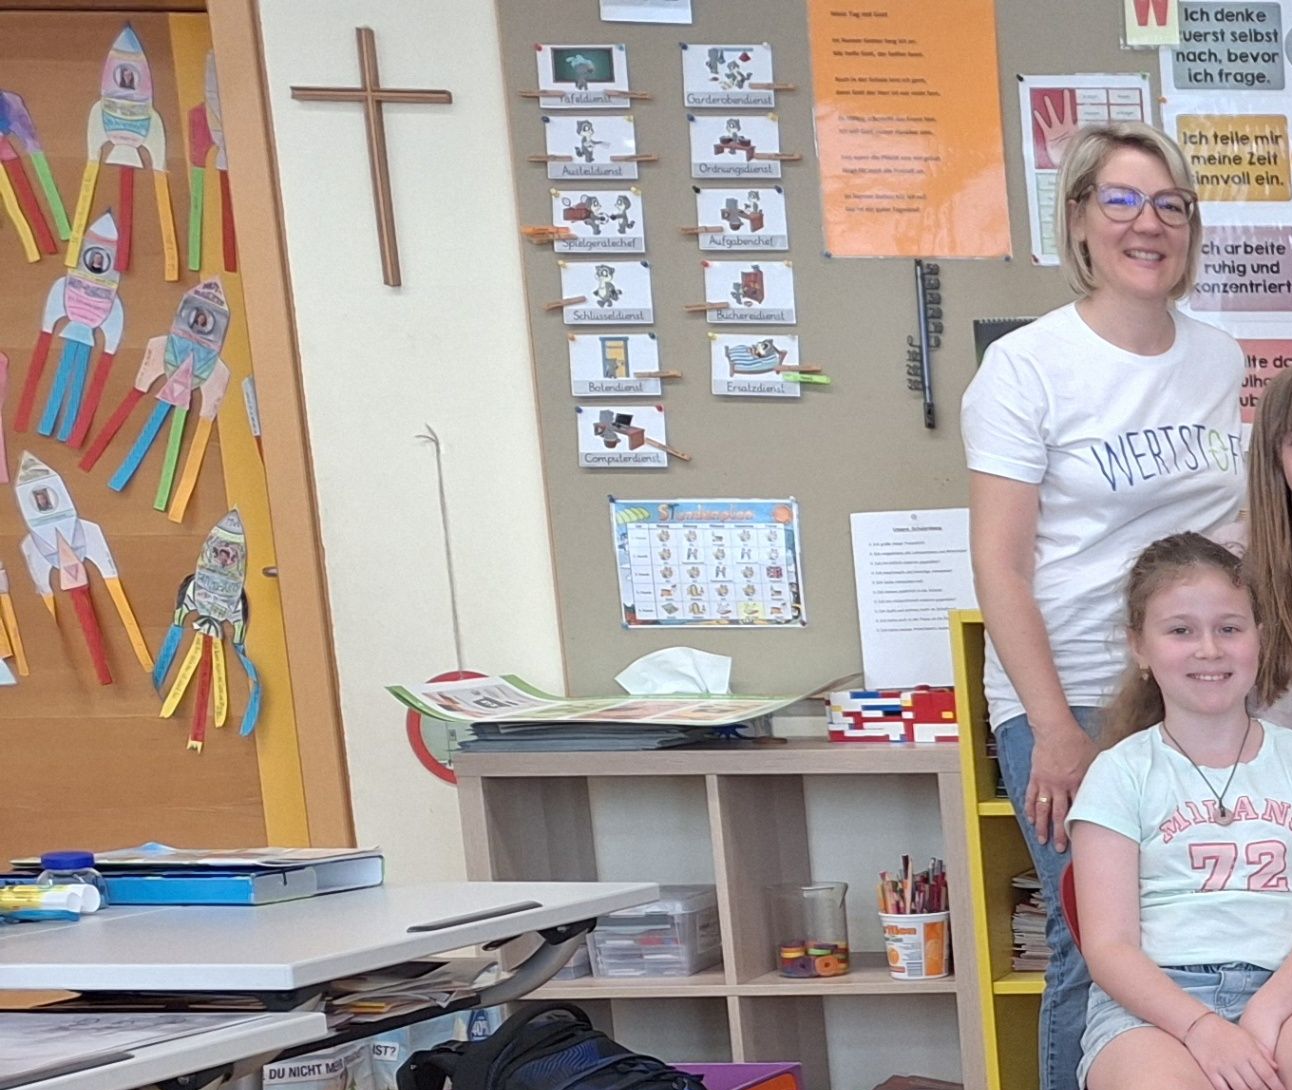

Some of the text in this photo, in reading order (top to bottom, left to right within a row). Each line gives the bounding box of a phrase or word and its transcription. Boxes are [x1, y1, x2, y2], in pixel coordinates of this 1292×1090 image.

[1184, 7, 1266, 22] Ich denke
[1179, 28, 1278, 43] uerst selbst
[1175, 49, 1278, 65] nach, bevor
[1188, 68, 1271, 86] ich frage.
[687, 94, 772, 106] Garderobendienst
[1183, 131, 1283, 146] Ich teile mir
[1191, 152, 1278, 166] meine Zeit
[699, 163, 772, 176] Ordnungsdienst
[1191, 172, 1284, 187] innvoll ein.
[709, 235, 776, 250] Aufgabenchef
[1224, 243, 1286, 256] arbeite
[1204, 261, 1280, 277] ruhig und
[588, 382, 643, 392] Botendienst
[727, 381, 785, 393] Ersatzdienst
[584, 453, 661, 465] Computerdienst
[1188, 840, 1289, 892] 72
[373, 1045, 396, 1056] IST?
[269, 1064, 322, 1080] DU NICHT
